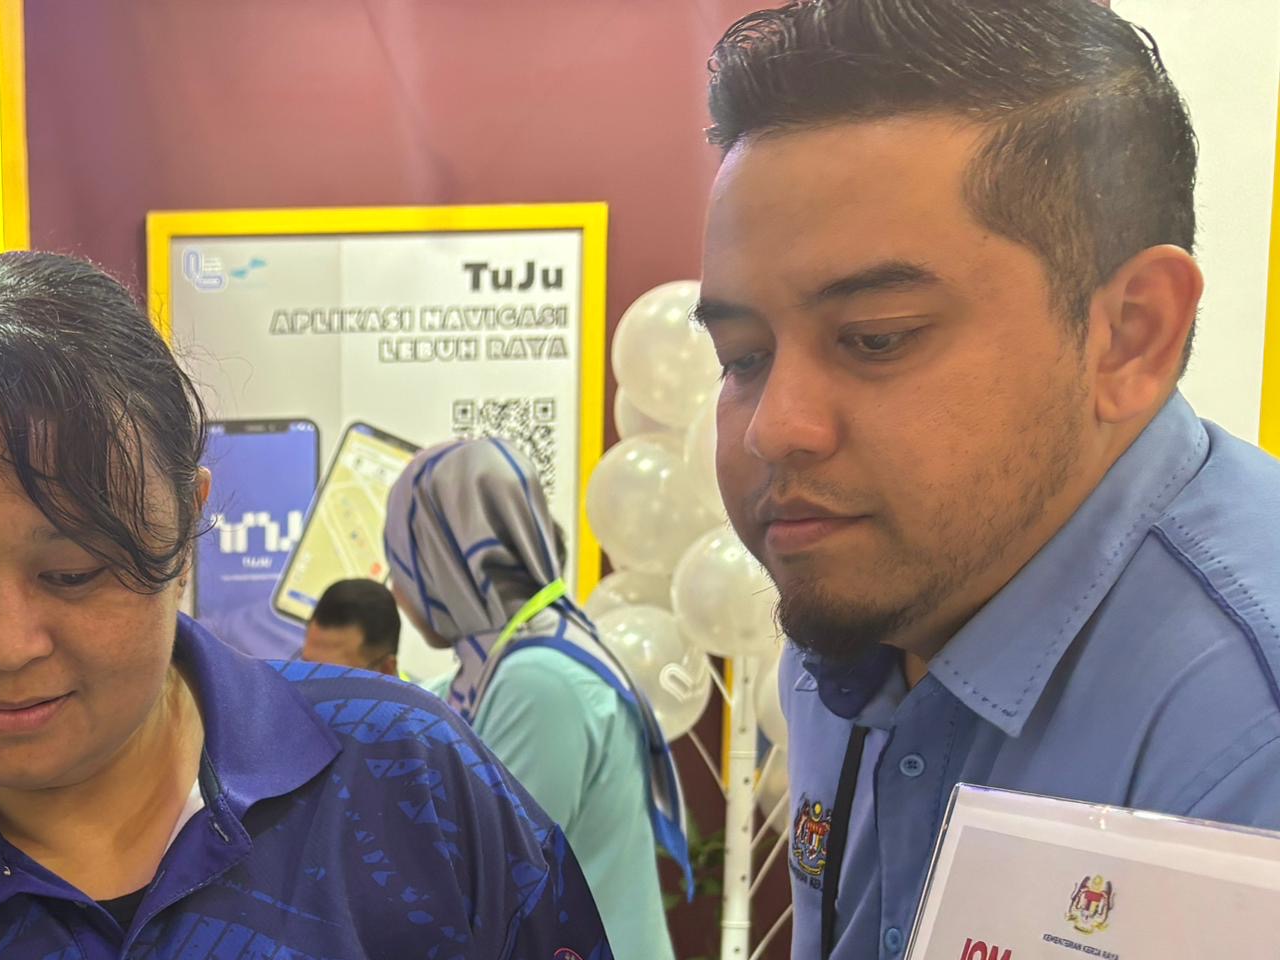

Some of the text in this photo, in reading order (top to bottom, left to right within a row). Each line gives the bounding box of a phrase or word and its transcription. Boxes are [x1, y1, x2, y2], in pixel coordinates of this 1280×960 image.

[464, 260, 564, 292] TuJu
[269, 304, 569, 335] APLIKASI NAVIGASI
[378, 335, 569, 362] LEBUH RAYA
